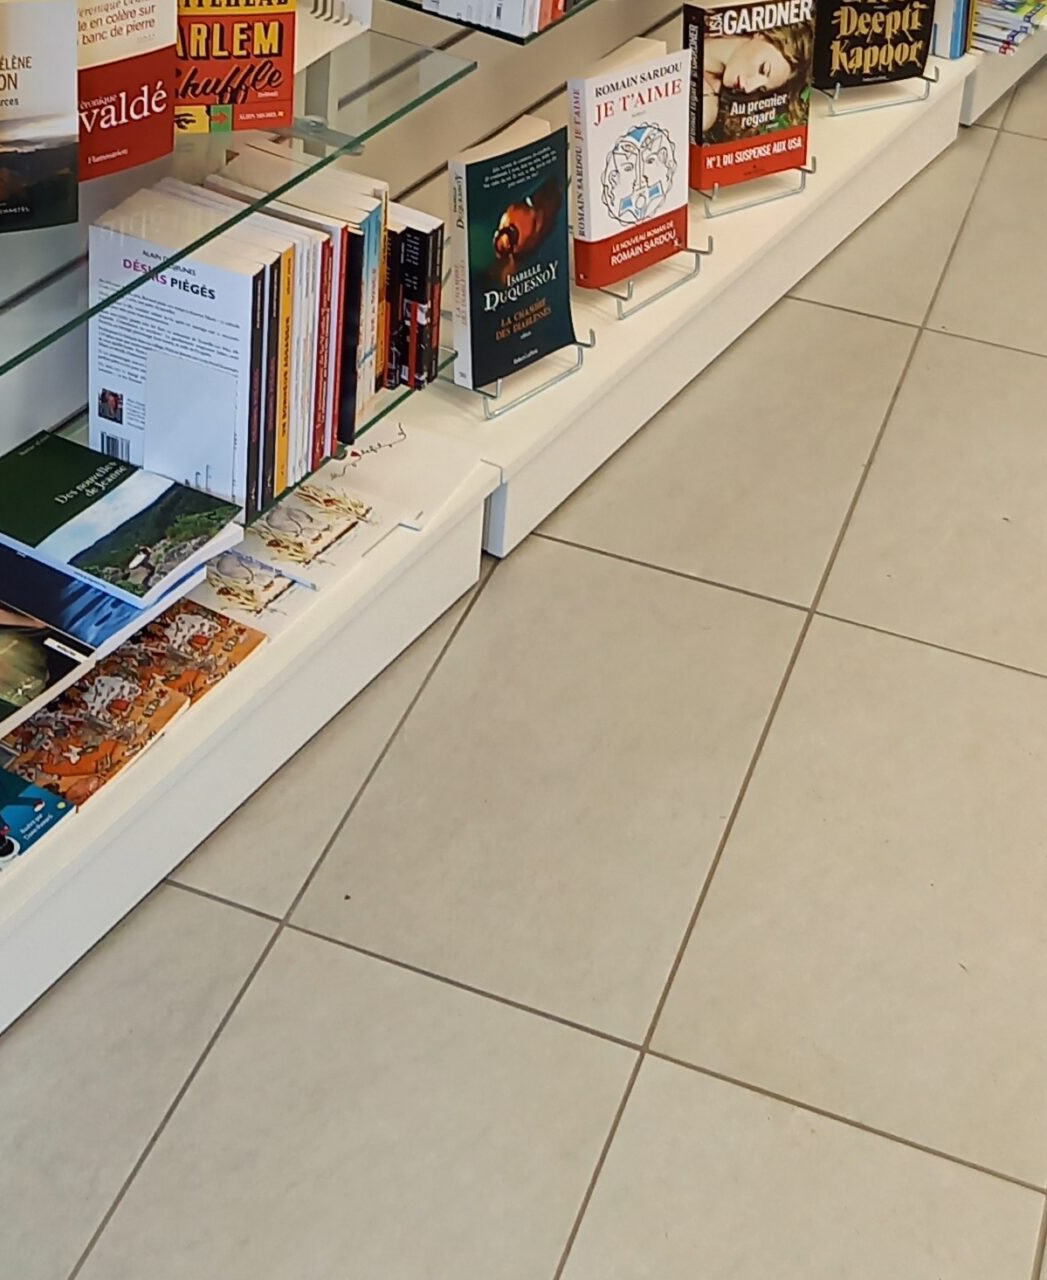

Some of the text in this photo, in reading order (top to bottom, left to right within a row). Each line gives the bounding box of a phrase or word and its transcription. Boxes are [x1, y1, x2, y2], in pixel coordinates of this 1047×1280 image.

[81, 18, 156, 46] banc de pierre
[712, 12, 724, 35] LISA
[832, 0, 927, 42] Deepti
[830, 38, 924, 76] Kapoor
[595, 62, 682, 98] ROMAIN SARDOU
[594, 79, 682, 126] JE T'AIME
[729, 94, 787, 116] Au premier
[741, 109, 775, 129] regard
[484, 261, 560, 312] DUQUESNOY
[506, 264, 542, 287] ISABELLE
[54, 462, 117, 504] Des nouvelles
[85, 465, 127, 497] de Jeanne
